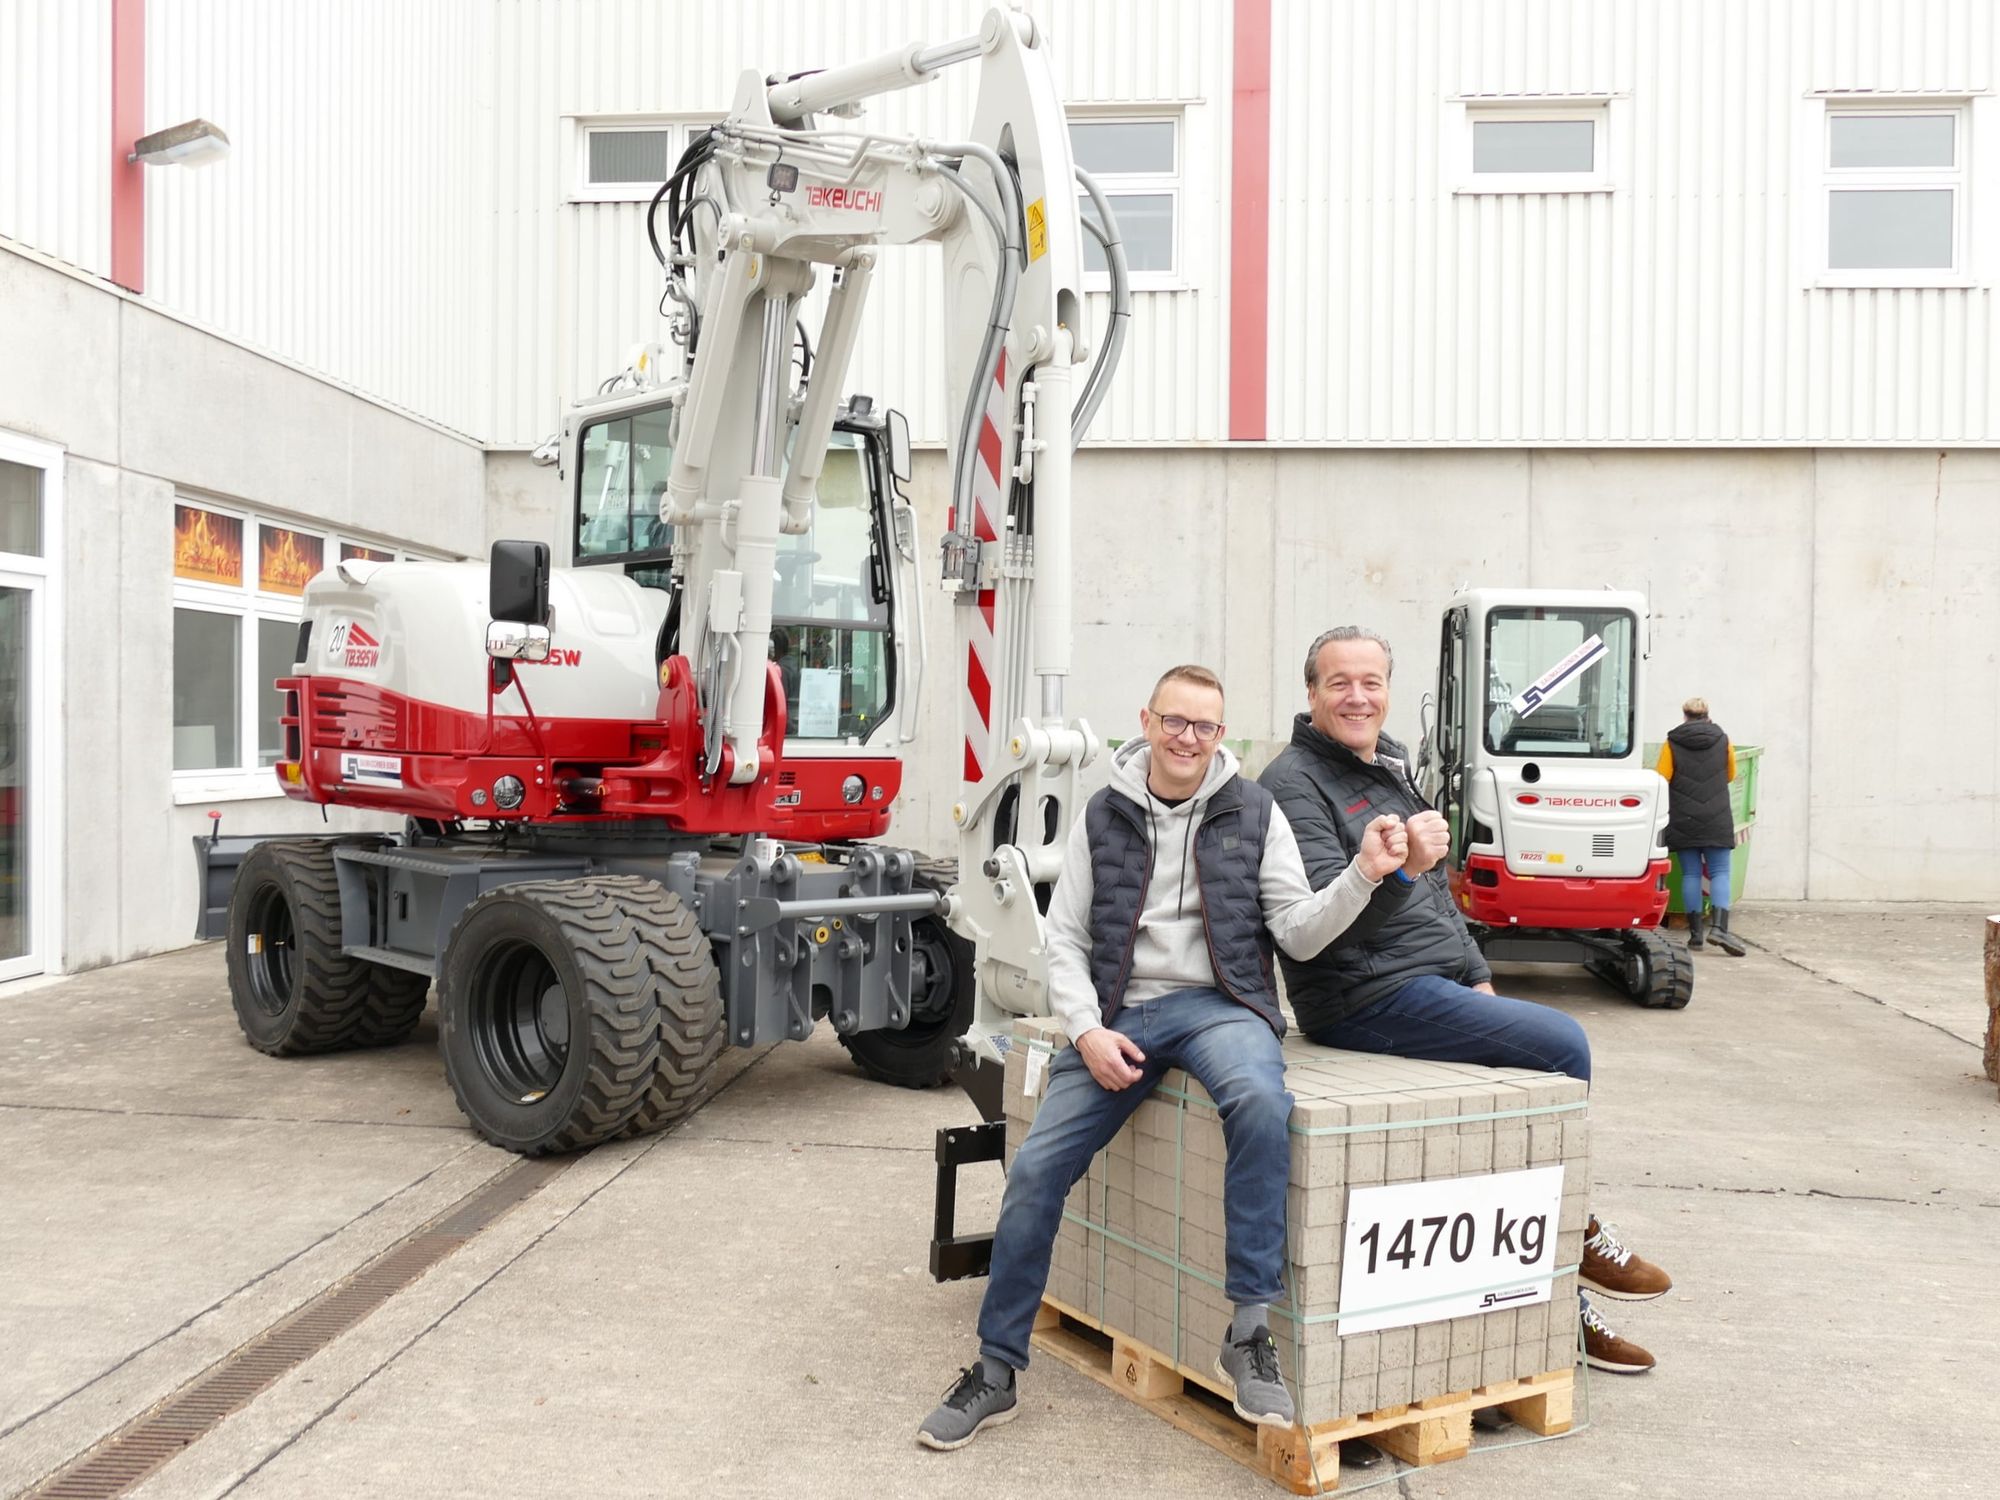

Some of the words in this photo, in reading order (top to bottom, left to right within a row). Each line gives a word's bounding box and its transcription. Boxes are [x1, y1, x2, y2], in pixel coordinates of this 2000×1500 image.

[329, 624, 346, 653] 20
[345, 649, 380, 668] TB395W
[1520, 852, 1543, 862] TB225
[1360, 1212, 1475, 1274] 1470
[1492, 1207, 1547, 1266] kg
